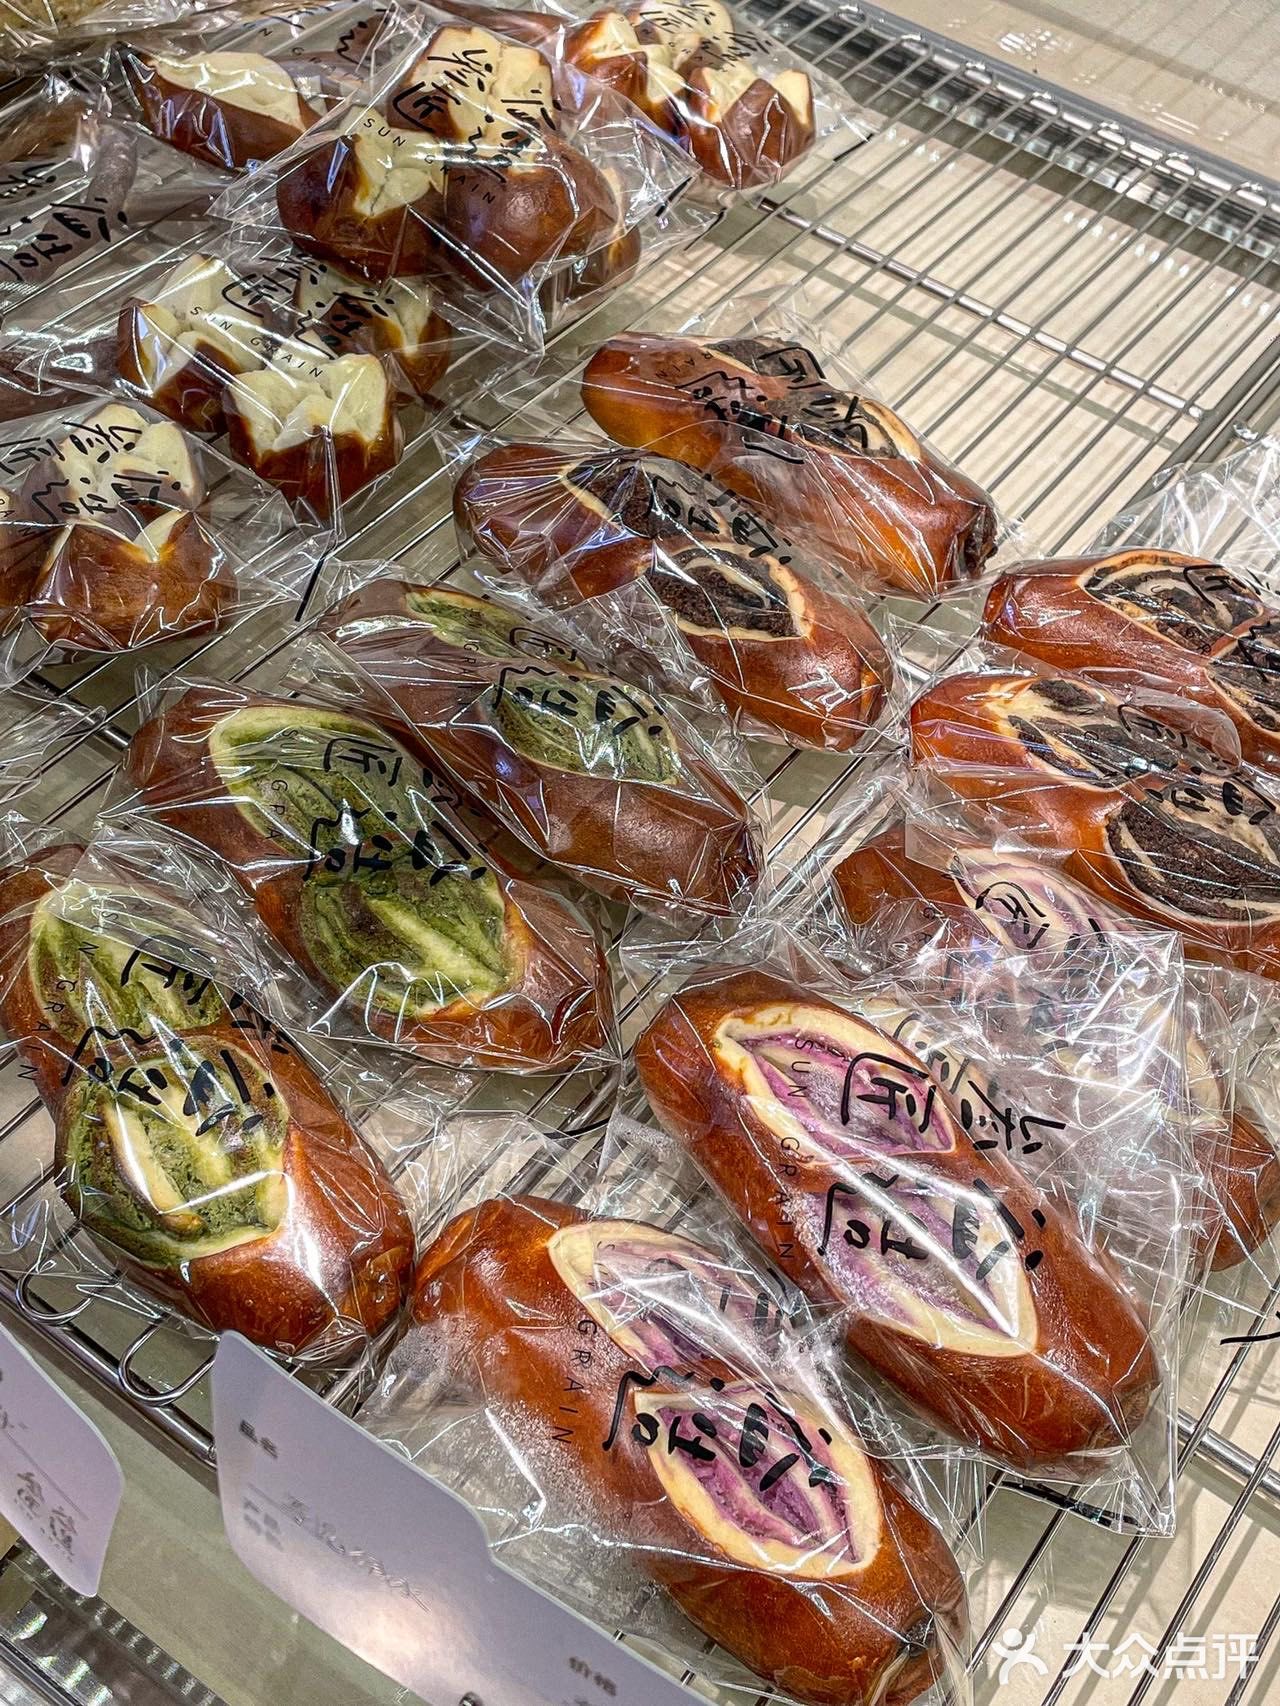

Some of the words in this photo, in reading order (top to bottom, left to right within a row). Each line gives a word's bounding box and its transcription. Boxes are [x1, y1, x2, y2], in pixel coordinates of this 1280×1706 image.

[363, 117, 406, 147] SUN
[189, 305, 232, 331] SN
[16, 978, 78, 1081] GRAIN
[786, 1038, 814, 1099] SUN
[778, 1135, 801, 1260] GRAIN
[551, 1318, 598, 1445] GRAIN
